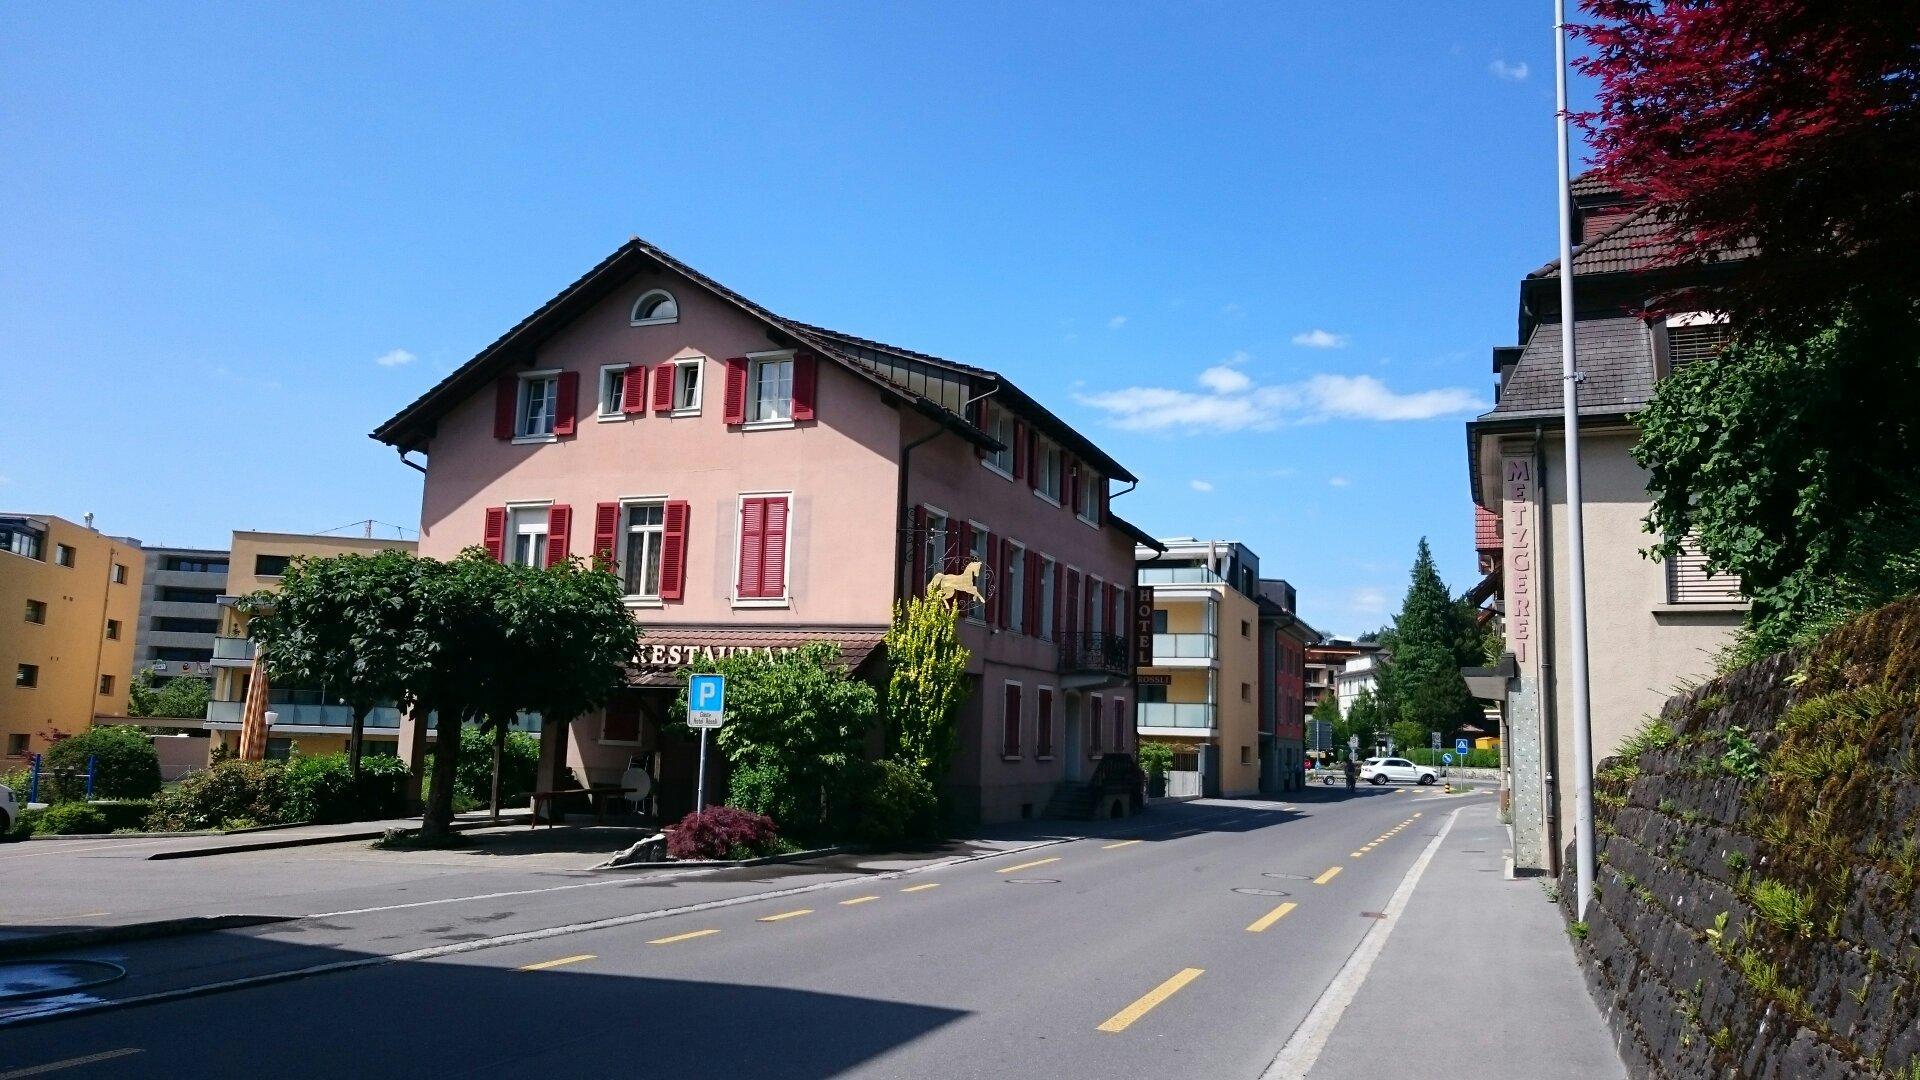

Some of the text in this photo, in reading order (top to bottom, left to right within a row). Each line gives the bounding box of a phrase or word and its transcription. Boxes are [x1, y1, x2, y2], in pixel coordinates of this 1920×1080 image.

[1507, 460, 1530, 663] METZGEREI
[1138, 589, 1151, 663] HOTEL
[631, 644, 798, 665] RESTAURAN
[700, 682, 715, 707] P
